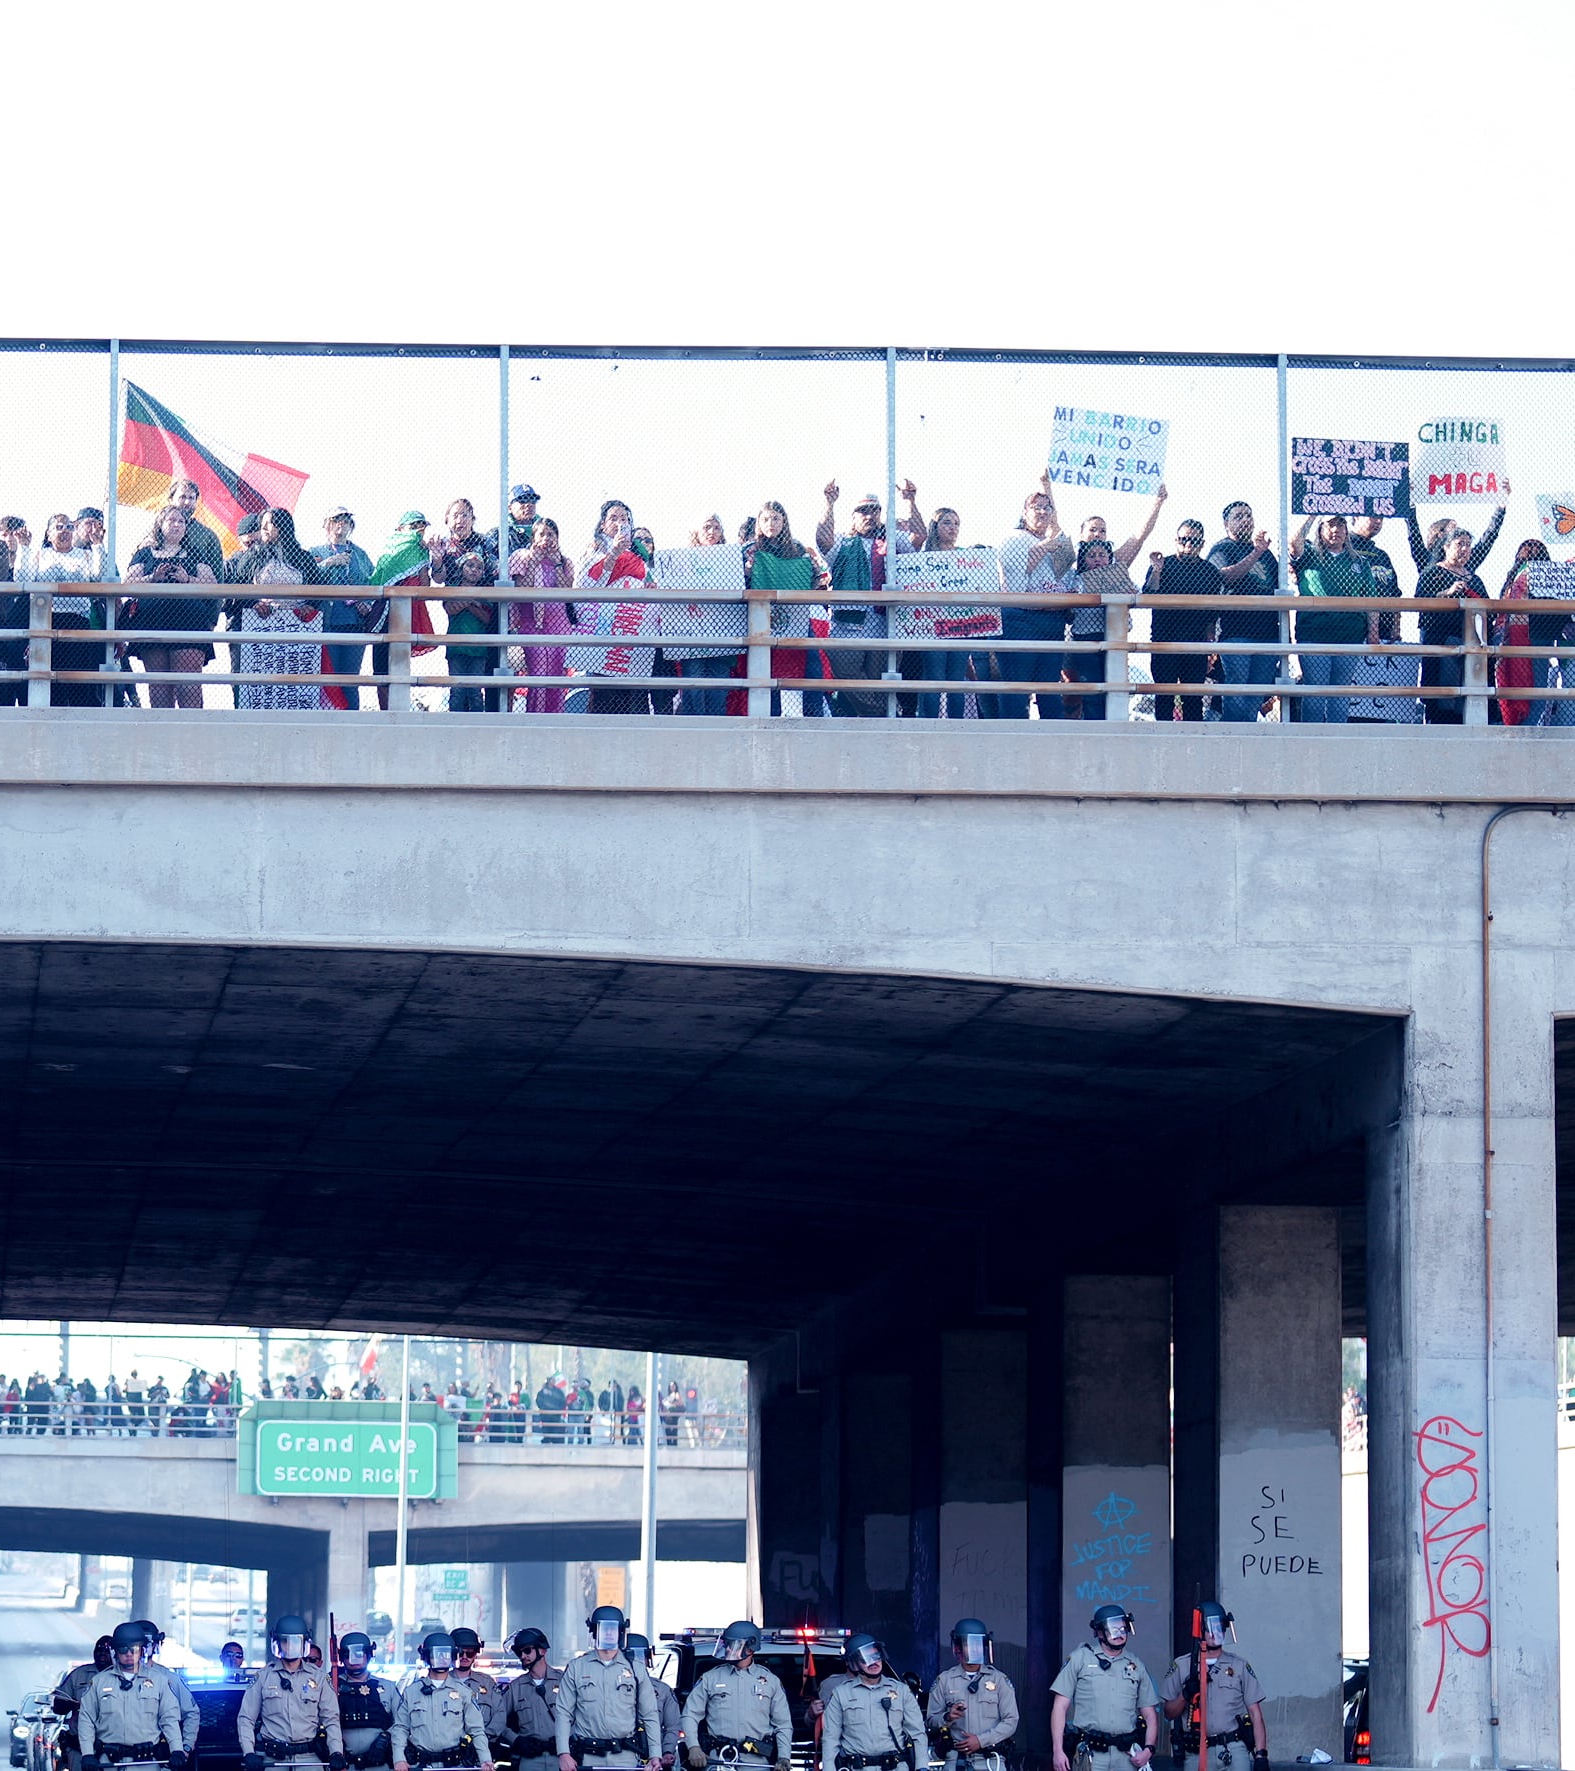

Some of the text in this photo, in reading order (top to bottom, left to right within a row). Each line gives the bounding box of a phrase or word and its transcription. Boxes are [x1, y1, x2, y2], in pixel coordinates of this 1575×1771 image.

[1054, 406, 1161, 435] MI BARRIO
[1070, 428, 1131, 450] UNIDO
[1418, 422, 1499, 444] CHINGA
[1048, 448, 1160, 476] JAMAS SERA
[1049, 467, 1150, 494] VENCIDO
[1429, 472, 1498, 495] MAGA
[277, 1433, 418, 1453] Grand Ave
[275, 1466, 351, 1482] SECOND
[1251, 1516, 1294, 1544] SE
[1071, 1533, 1152, 1567] JUSTICE
[1242, 1554, 1323, 1578] PUEDE
